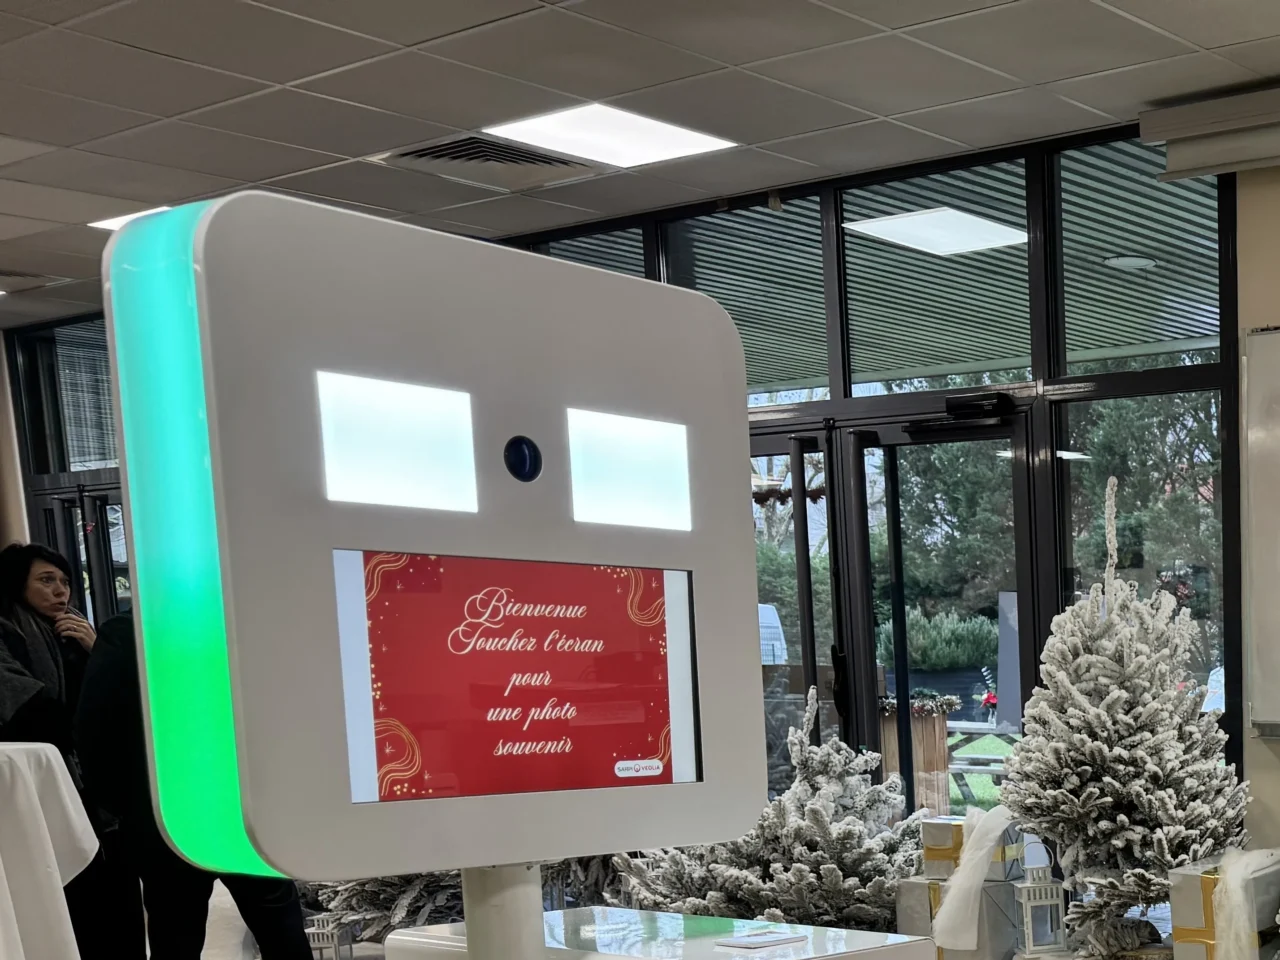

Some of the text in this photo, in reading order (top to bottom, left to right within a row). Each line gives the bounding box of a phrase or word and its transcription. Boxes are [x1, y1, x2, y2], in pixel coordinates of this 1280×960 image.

[464, 587, 587, 622] Bienvenue
[448, 618, 605, 655] Touchez l'écran
[504, 670, 553, 696] pour
[487, 697, 577, 731] une photo
[493, 736, 574, 757] souvenir
